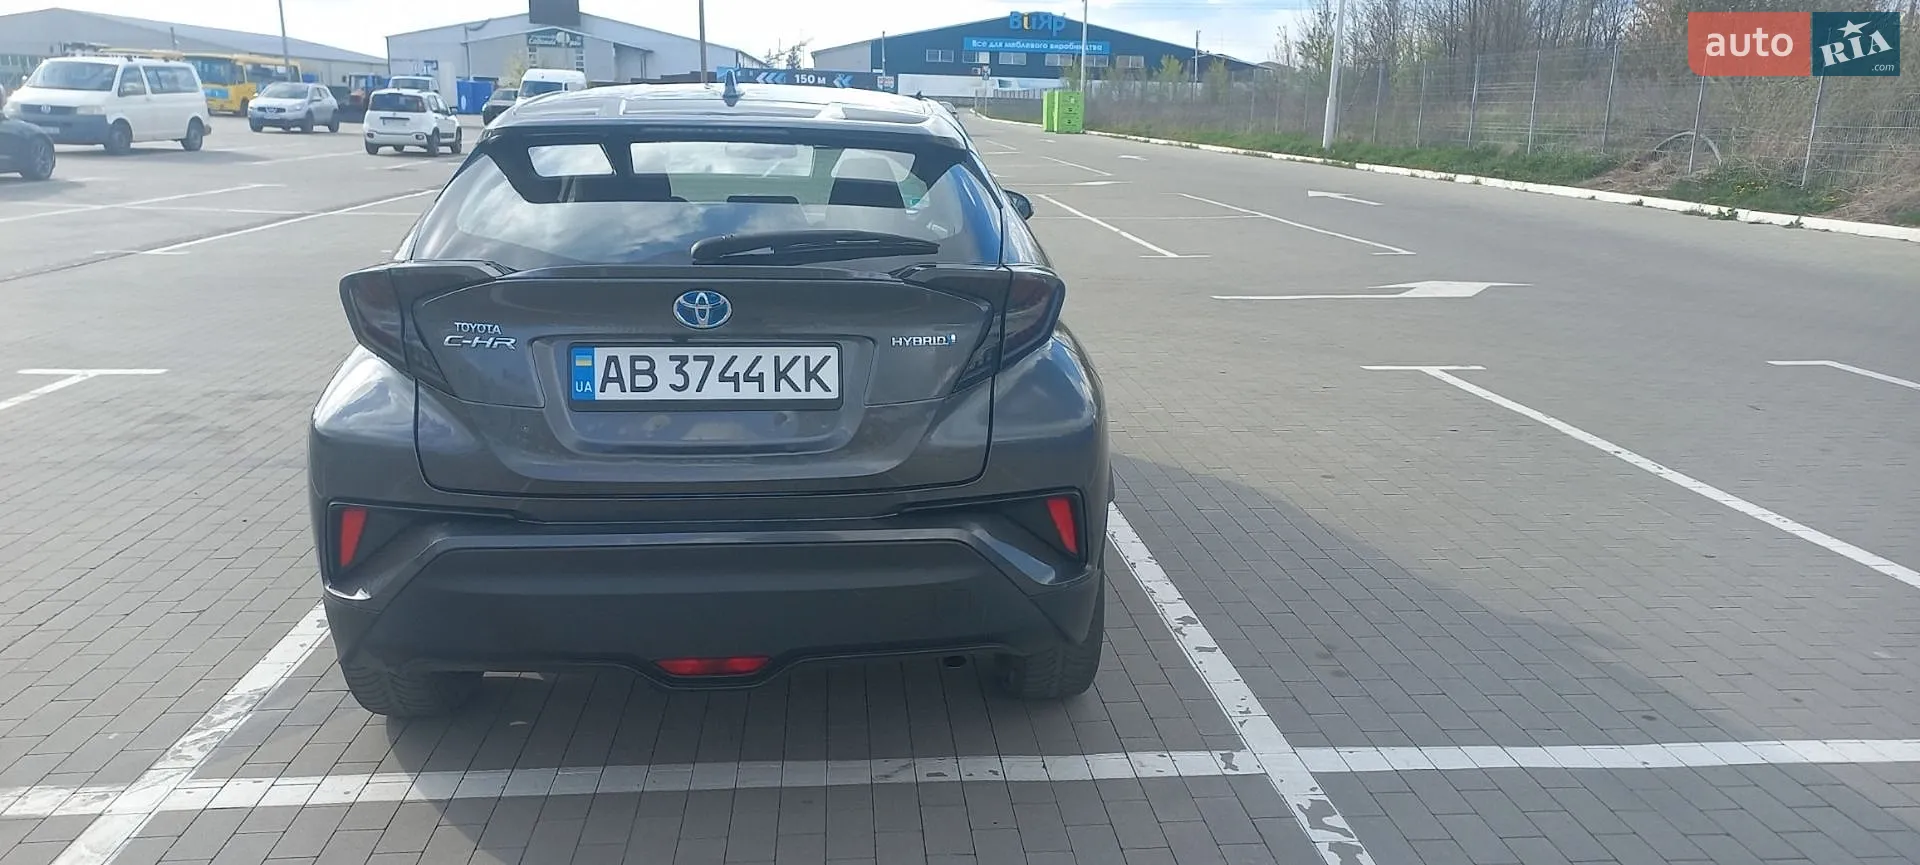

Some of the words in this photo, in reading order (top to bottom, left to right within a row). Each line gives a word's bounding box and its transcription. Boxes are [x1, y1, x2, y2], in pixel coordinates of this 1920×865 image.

[794, 74, 816, 84] 150
[453, 321, 502, 335] TOYOTA
[443, 335, 517, 351] C-HR
[891, 335, 948, 346] HYBRID
[599, 355, 659, 393] AB
[668, 355, 765, 393] 3744
[575, 381, 593, 393] UA
